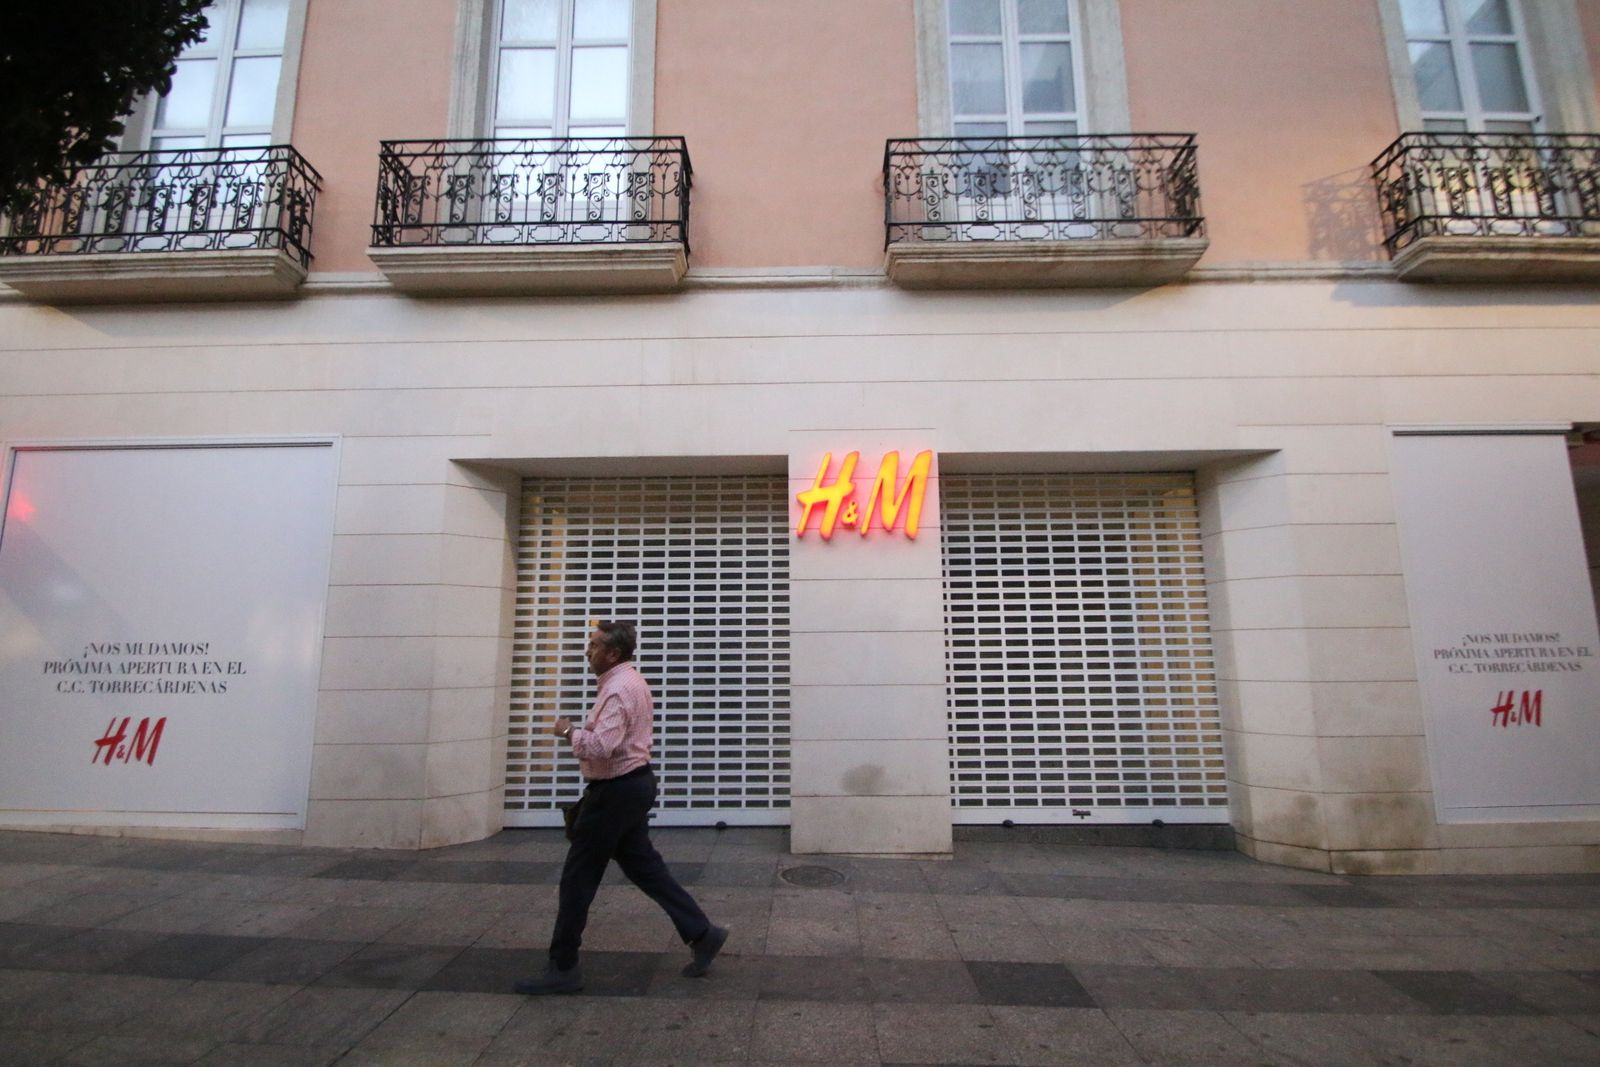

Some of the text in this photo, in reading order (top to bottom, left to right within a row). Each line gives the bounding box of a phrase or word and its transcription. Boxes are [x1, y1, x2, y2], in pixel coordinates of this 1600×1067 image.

[796, 449, 932, 541] H&M
[1493, 632, 1560, 644] MUDAMOS!
[83, 642, 209, 659] ¡NOS MUDAMOS!
[1434, 646, 1593, 660] PRÓXIMA APERTURA EN EL
[43, 658, 247, 675] PRÓXIMA APERTURA EN EL
[1448, 660, 1583, 674] C.C. TORRECÁRDENAS
[57, 678, 228, 694] C.C. TORRECÁRDENAS
[1490, 690, 1543, 728] H&M
[92, 716, 167, 767] H&M
